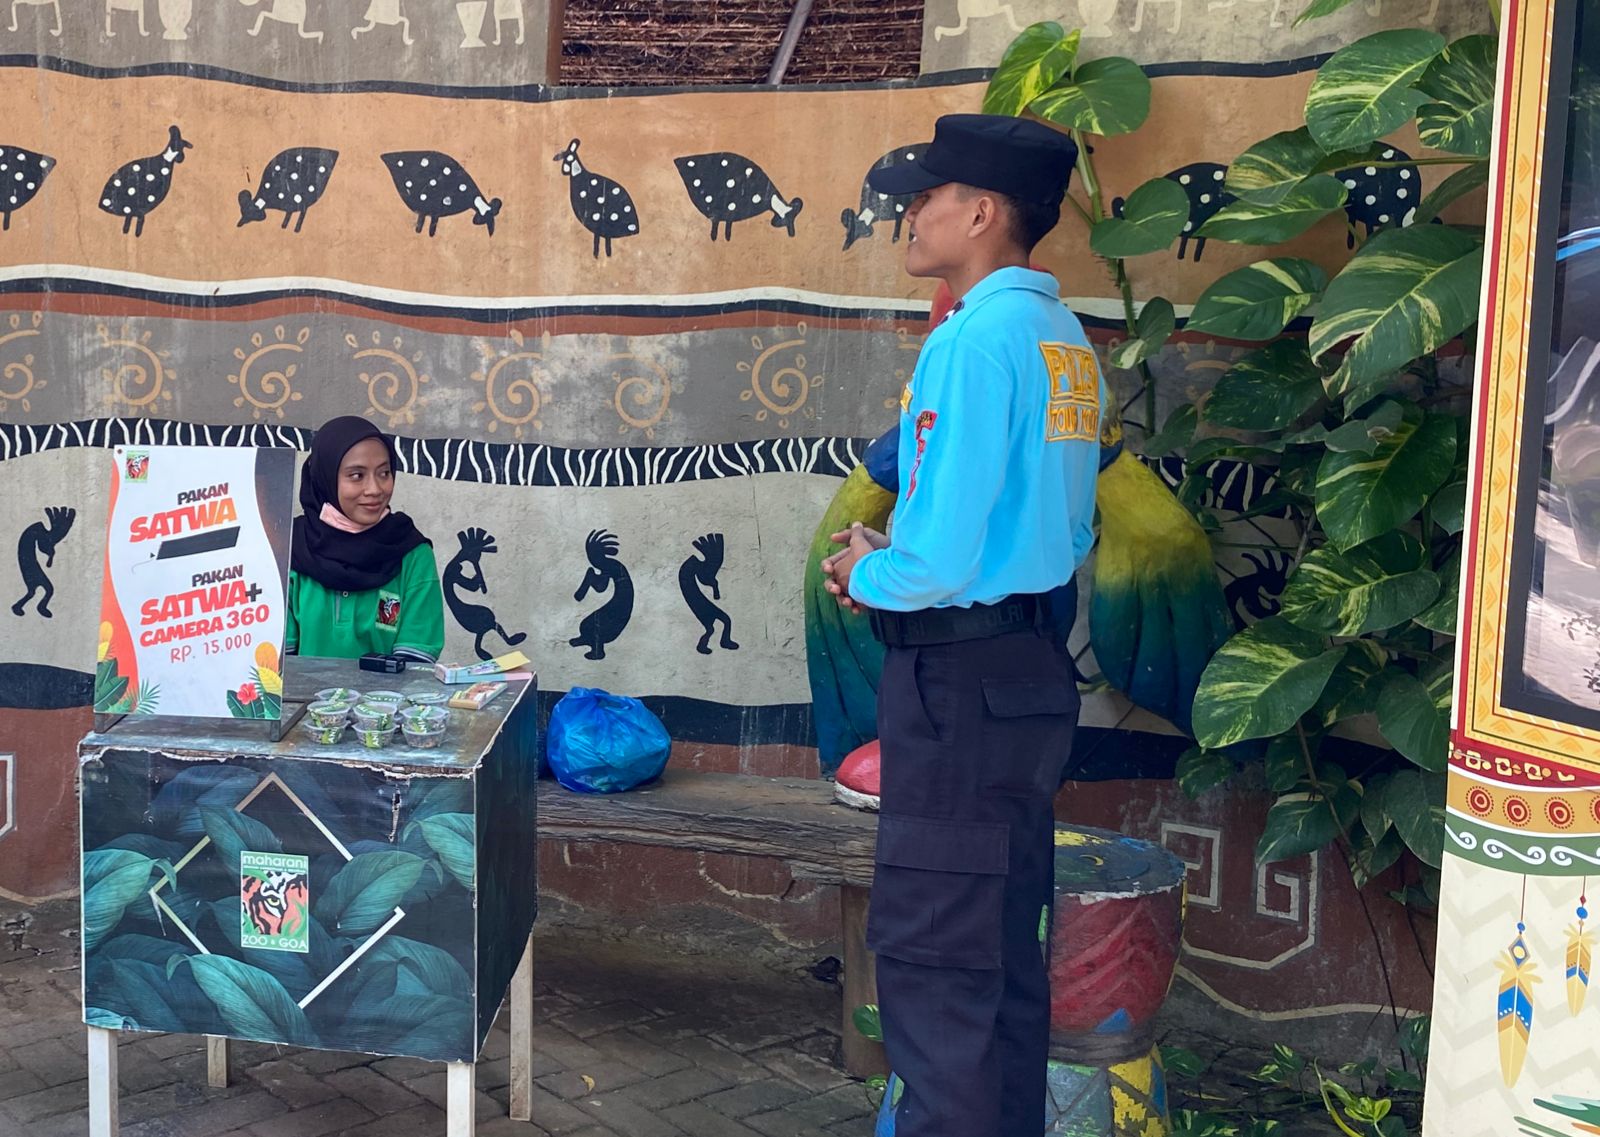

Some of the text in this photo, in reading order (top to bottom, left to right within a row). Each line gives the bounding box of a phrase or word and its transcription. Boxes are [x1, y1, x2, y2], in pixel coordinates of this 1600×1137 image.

[177, 482, 229, 506] PAKAN
[129, 497, 238, 543] SATWA
[192, 564, 244, 587] PAKAN
[139, 604, 270, 647] CAMERA 360
[170, 632, 252, 663] RP. 15.000
[243, 854, 307, 869] maharani
[243, 934, 268, 946] ZOO
[278, 937, 307, 949] GOA
